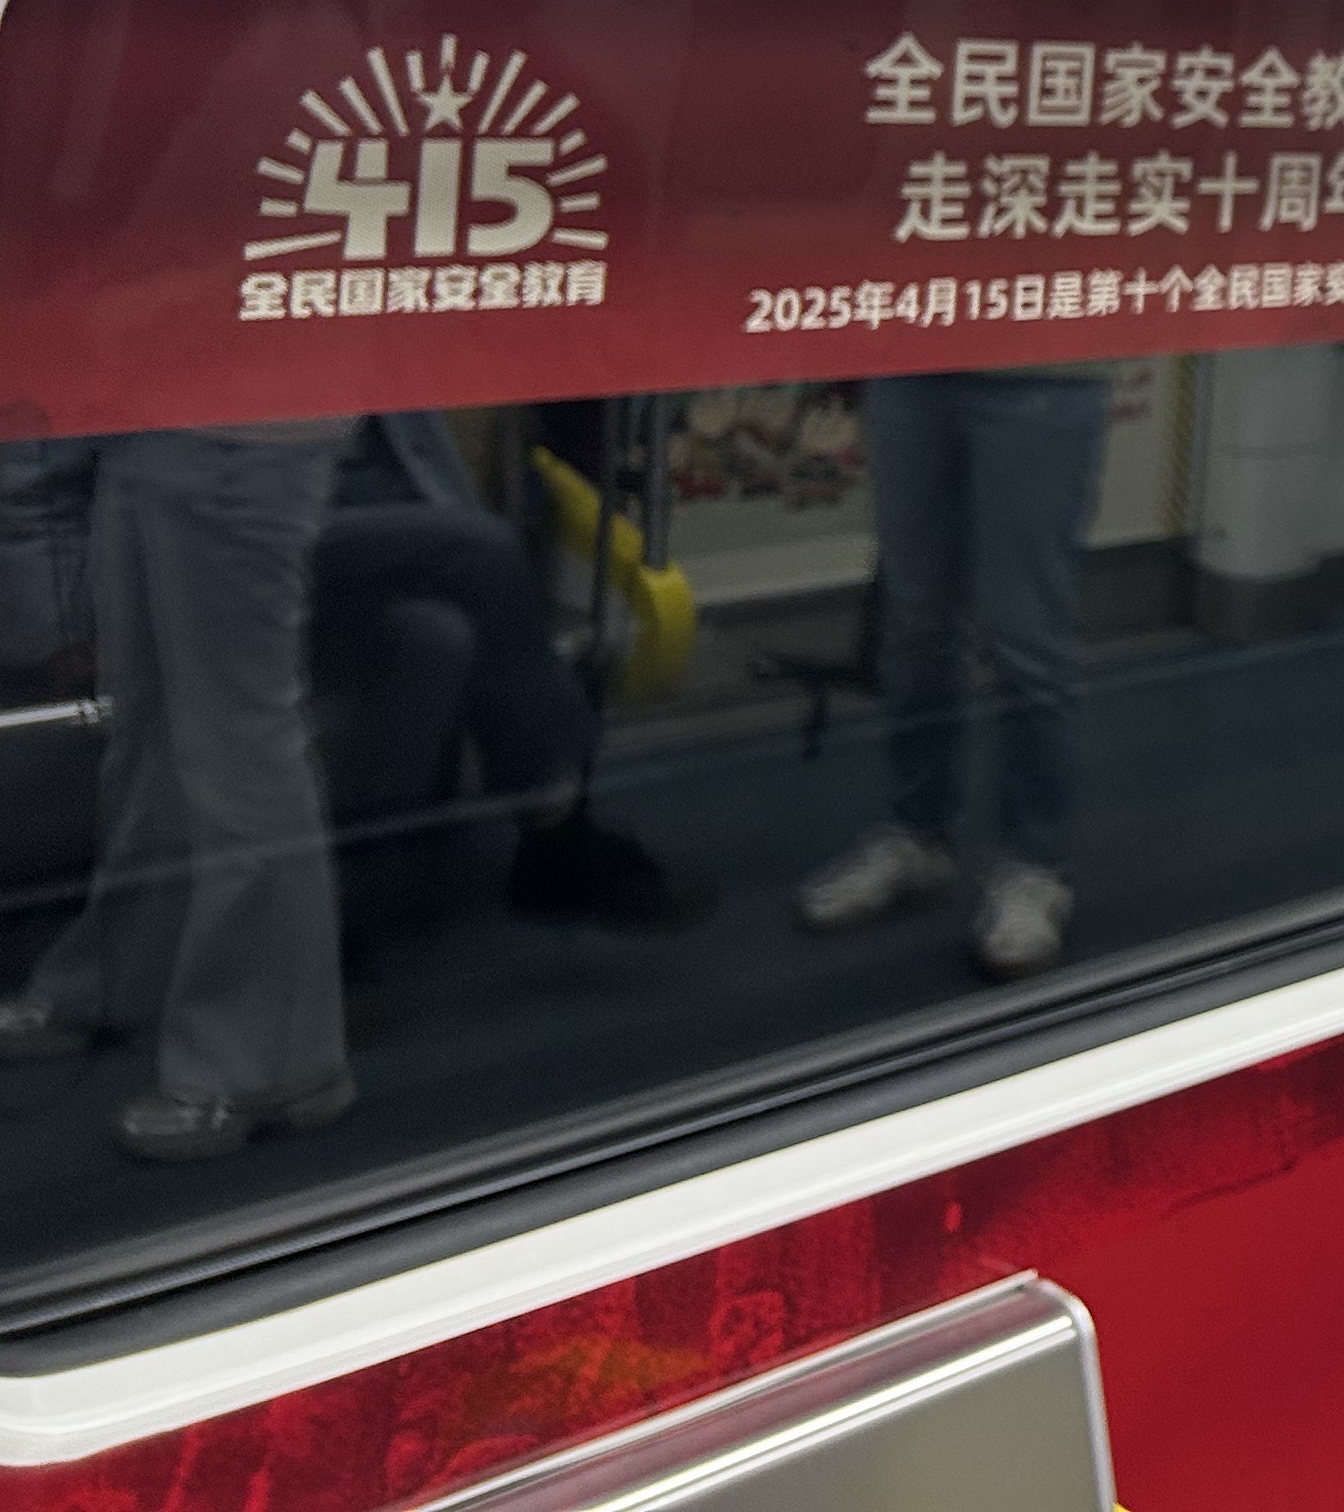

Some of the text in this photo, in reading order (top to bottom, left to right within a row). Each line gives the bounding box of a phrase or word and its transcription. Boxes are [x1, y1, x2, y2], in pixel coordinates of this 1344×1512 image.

[303, 136, 555, 261] 415
[239, 258, 606, 322] 全民国家安全教育
